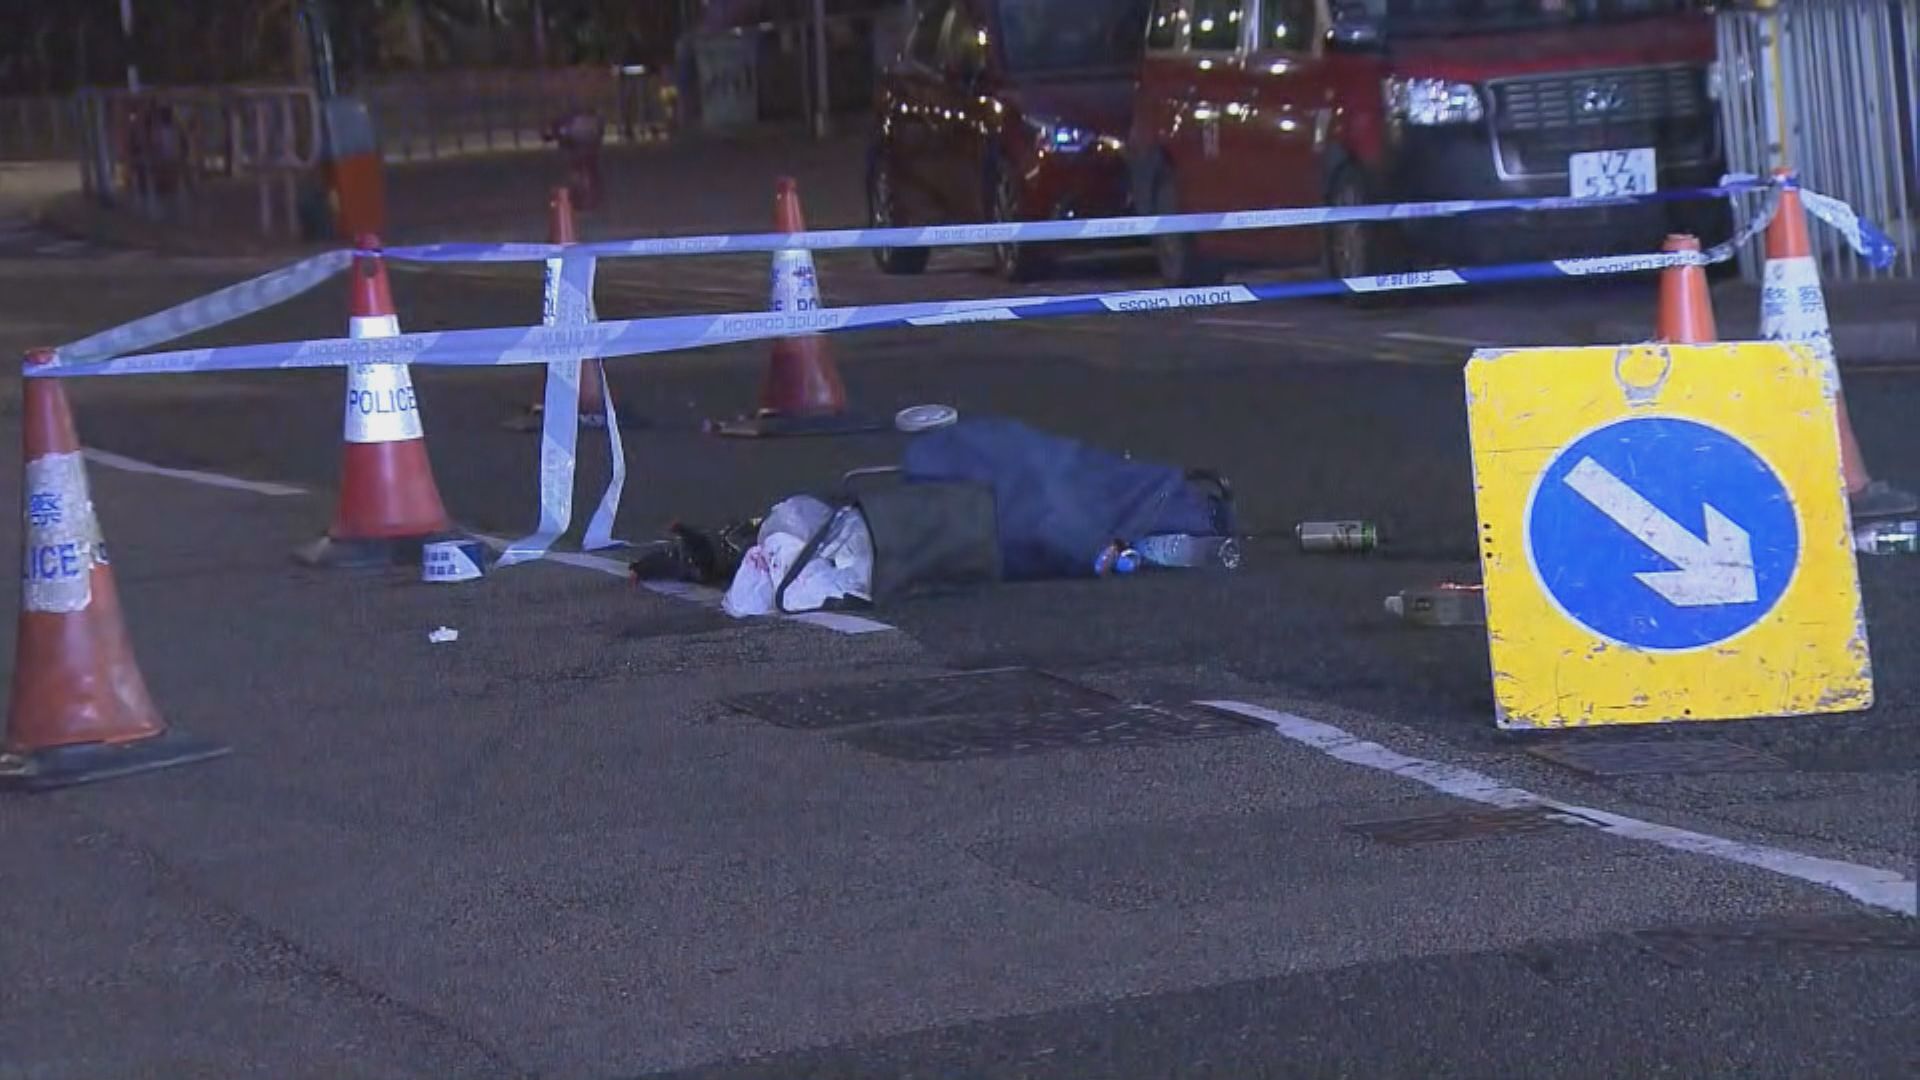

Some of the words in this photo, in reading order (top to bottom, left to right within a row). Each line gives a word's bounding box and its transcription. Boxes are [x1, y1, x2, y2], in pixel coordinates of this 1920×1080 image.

[1601, 152, 1632, 174] VZ
[1585, 174, 1647, 197] 5341
[1178, 293, 1206, 307] NOT
[1209, 290, 1231, 305] DO
[348, 386, 416, 414] POLICE
